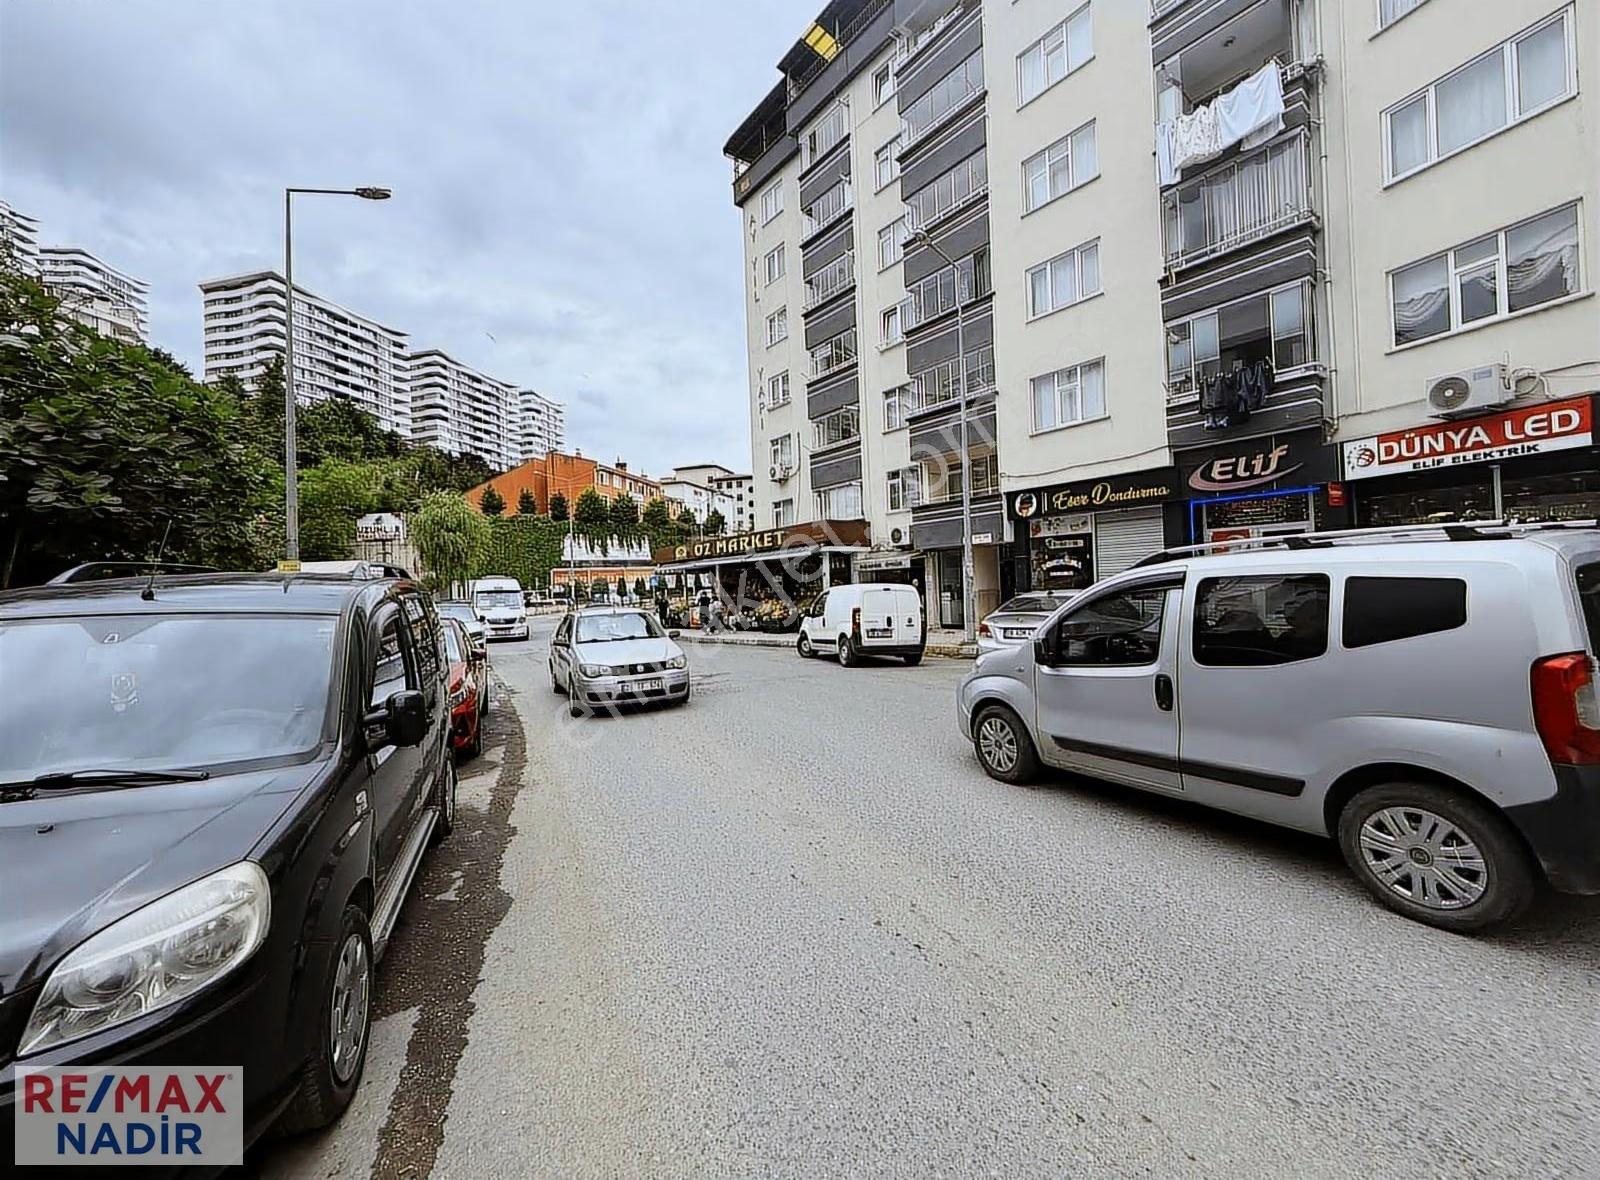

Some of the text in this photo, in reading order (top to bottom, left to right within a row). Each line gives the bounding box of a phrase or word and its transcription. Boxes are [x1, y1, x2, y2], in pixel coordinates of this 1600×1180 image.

[756, 367, 766, 430] YAPI
[1378, 408, 1582, 463] DÜNYA LED
[1412, 442, 1540, 470] ELİF ELEKTRİK
[1052, 481, 1171, 511] Eser Dondurma
[715, 530, 786, 553] MARKET
